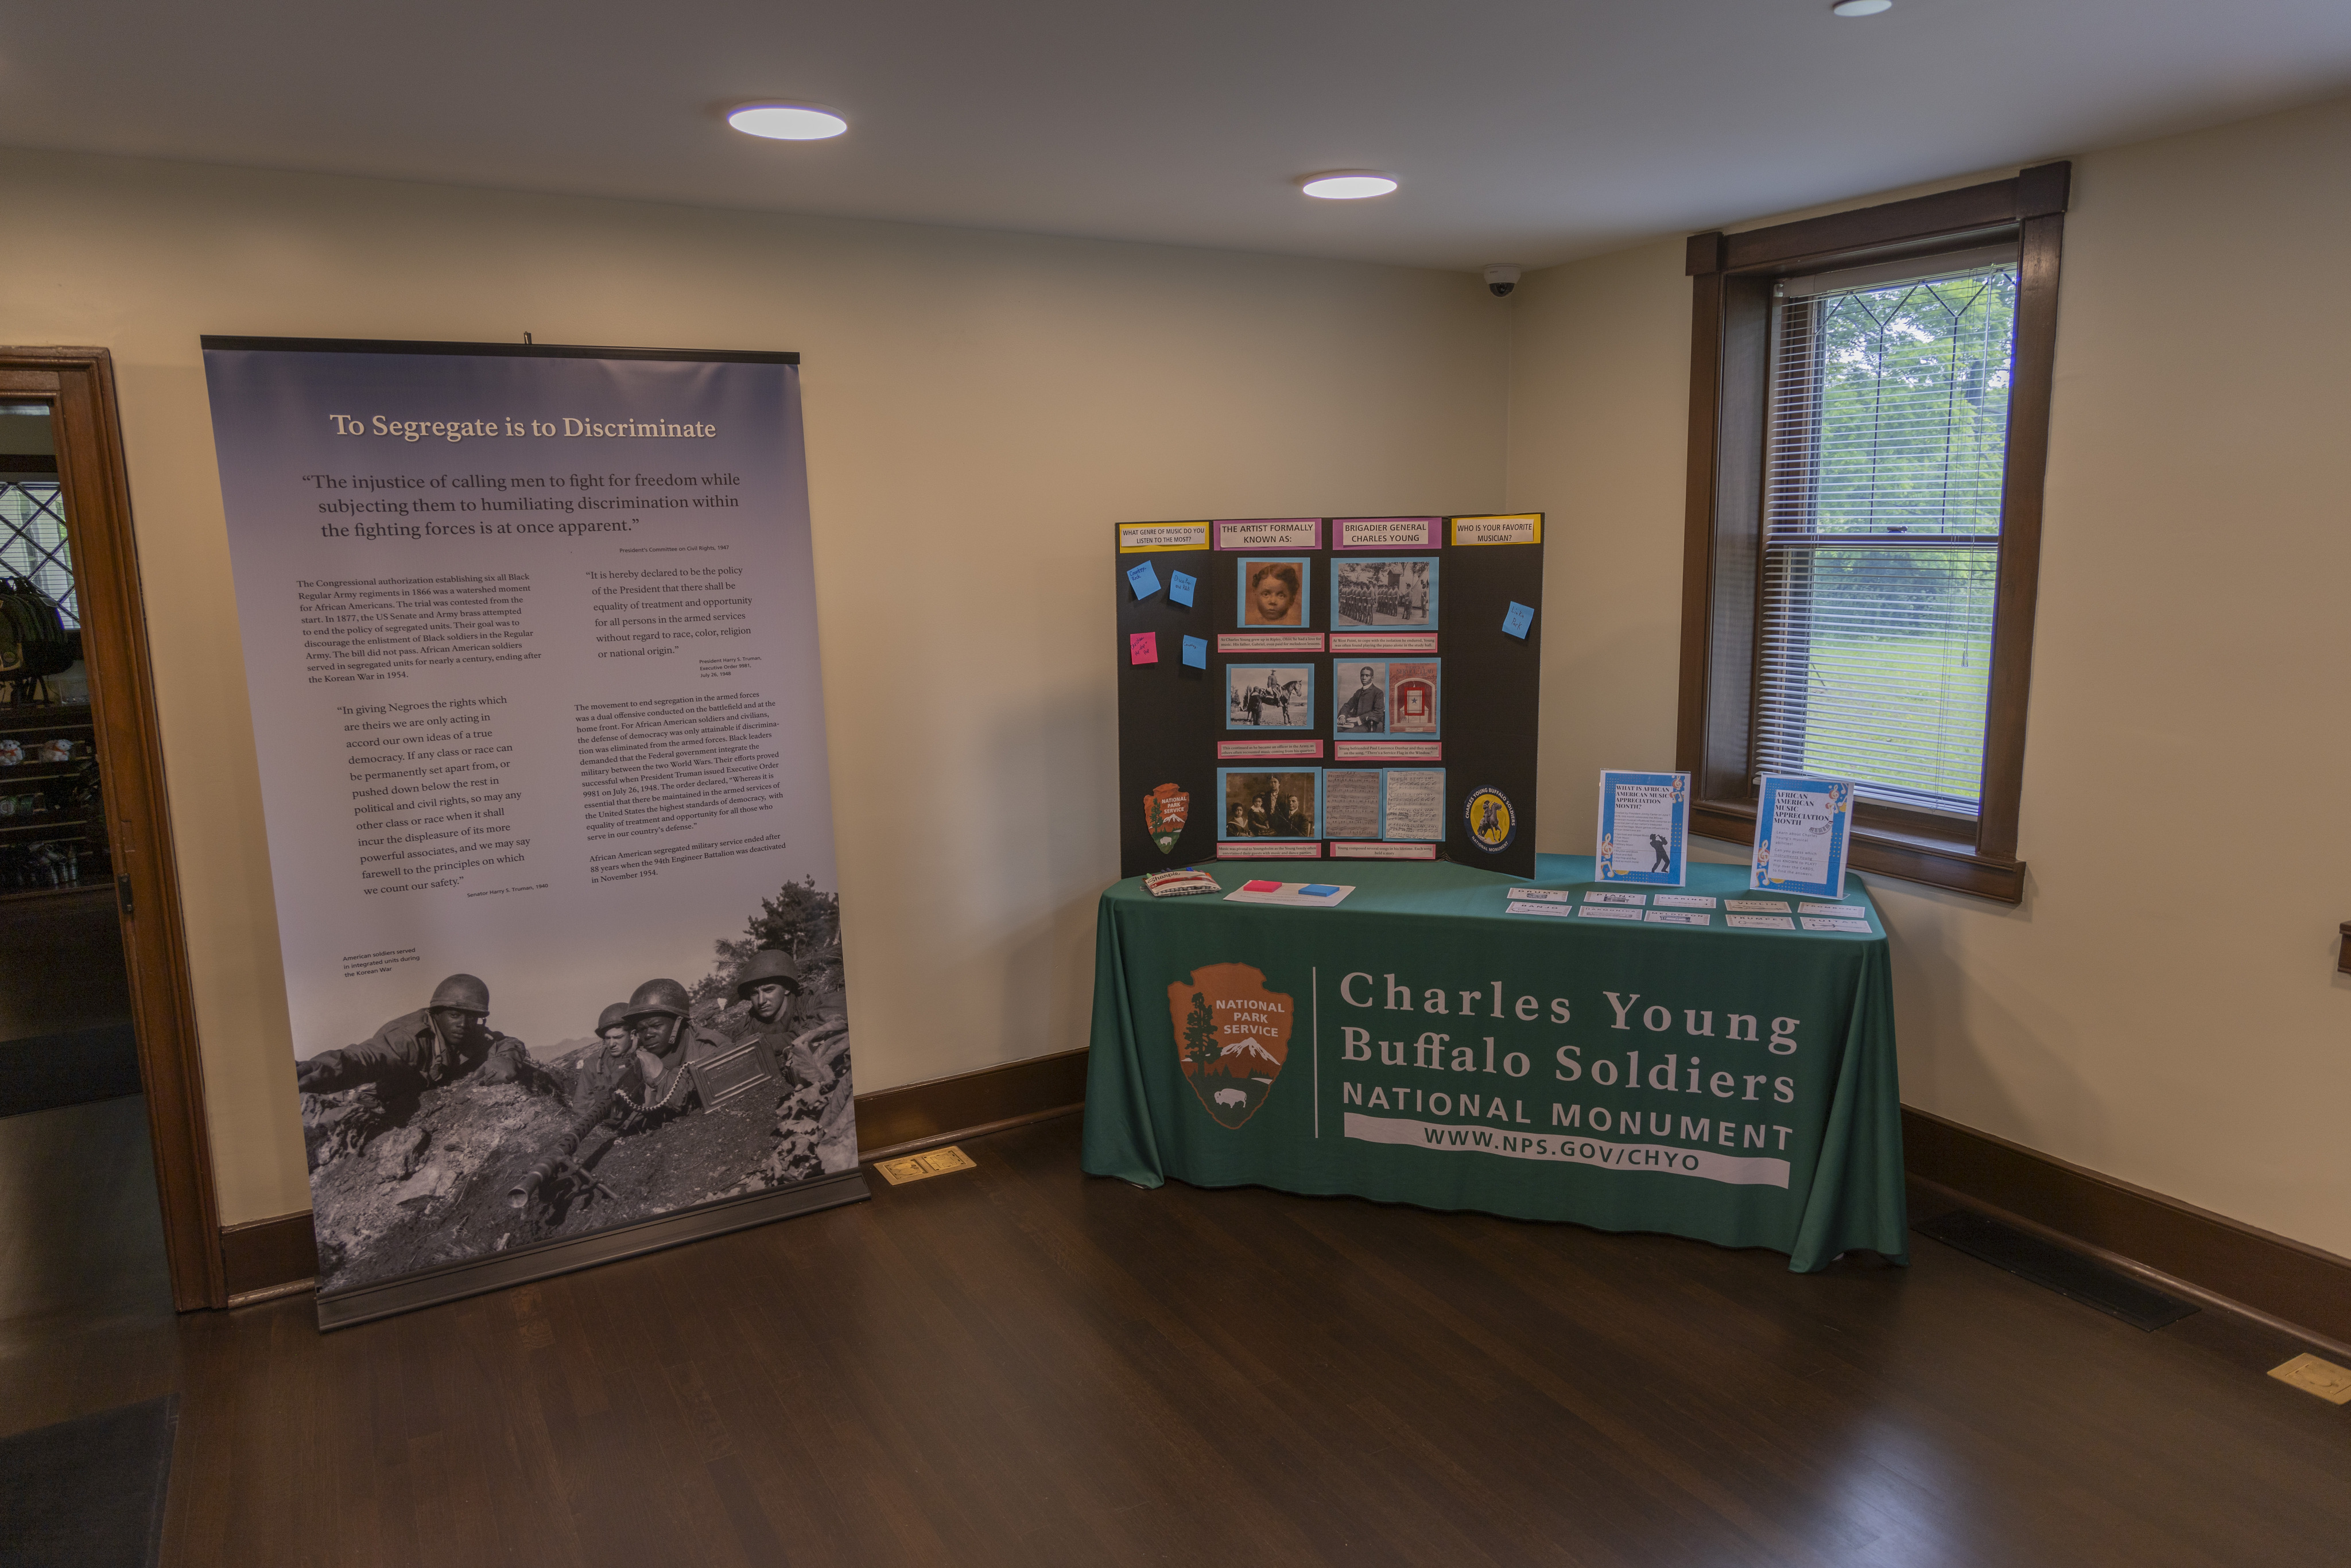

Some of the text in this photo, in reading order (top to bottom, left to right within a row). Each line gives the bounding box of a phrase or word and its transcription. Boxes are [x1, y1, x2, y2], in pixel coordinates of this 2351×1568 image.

[329, 414, 716, 442] To Segregate is to Discriminate
[302, 472, 740, 492] “The injustice of calling men to fight for freedom while
[319, 495, 739, 517] subjecting them to humiliating discrimination within
[321, 518, 639, 540] the fighting forces is at once apparent.”
[1465, 787, 1515, 826] CHARLES YOUNG BUFFALO SOLDIERS
[1774, 812, 1829, 821] APPRECIATION
[1472, 836, 1508, 852] NATIONAL MONUMENT
[1147, 872, 1180, 884] Sharpie
[351, 959, 383, 968] integrated
[1216, 999, 1285, 1014] NATIONAL
[1340, 972, 1800, 1055] Charles Young
[1233, 1012, 1268, 1023] PARK
[1223, 1024, 1278, 1038] SERVICE
[1341, 1027, 1794, 1103] Buffalo Soldiers
[1343, 1082, 1793, 1150] NATIONAL MONUMENT
[1424, 1127, 1700, 1171] WWW.NPS.GOV/CHYO
